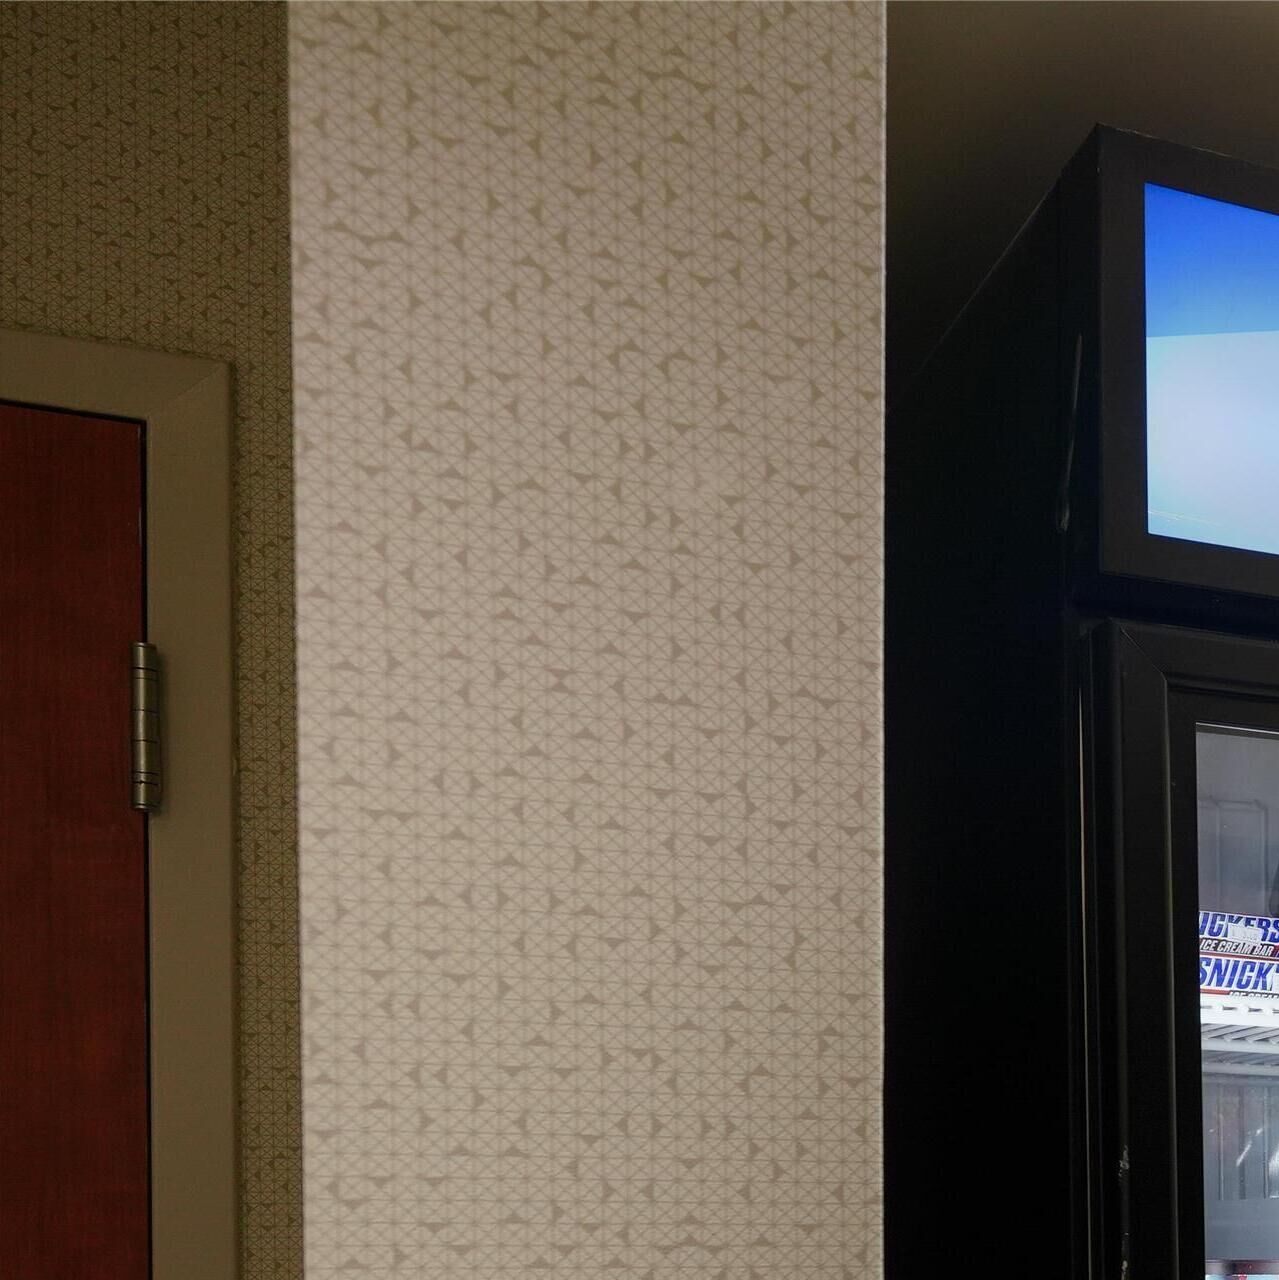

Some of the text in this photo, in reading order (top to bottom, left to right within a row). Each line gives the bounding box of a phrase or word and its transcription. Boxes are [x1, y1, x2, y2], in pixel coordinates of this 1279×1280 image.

[1200, 940, 1274, 956] ICE CREAM BAR
